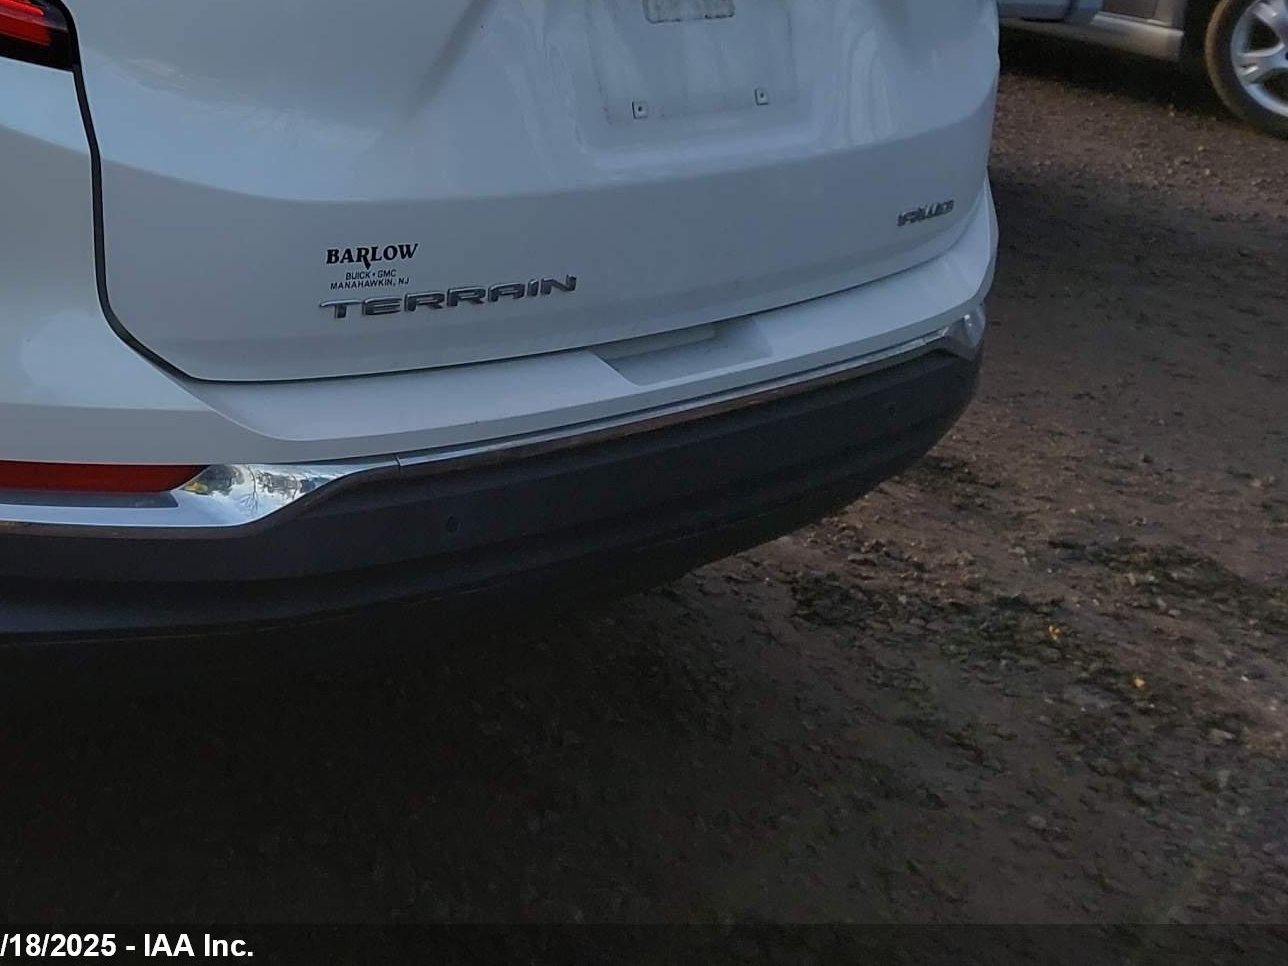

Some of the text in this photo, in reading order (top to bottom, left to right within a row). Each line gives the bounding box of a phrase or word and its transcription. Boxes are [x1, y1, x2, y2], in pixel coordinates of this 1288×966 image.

[326, 243, 418, 270] BARLOW
[345, 269, 397, 280] BUICK GMC
[398, 277, 410, 285] NJ
[319, 274, 577, 319] TERRAIN
